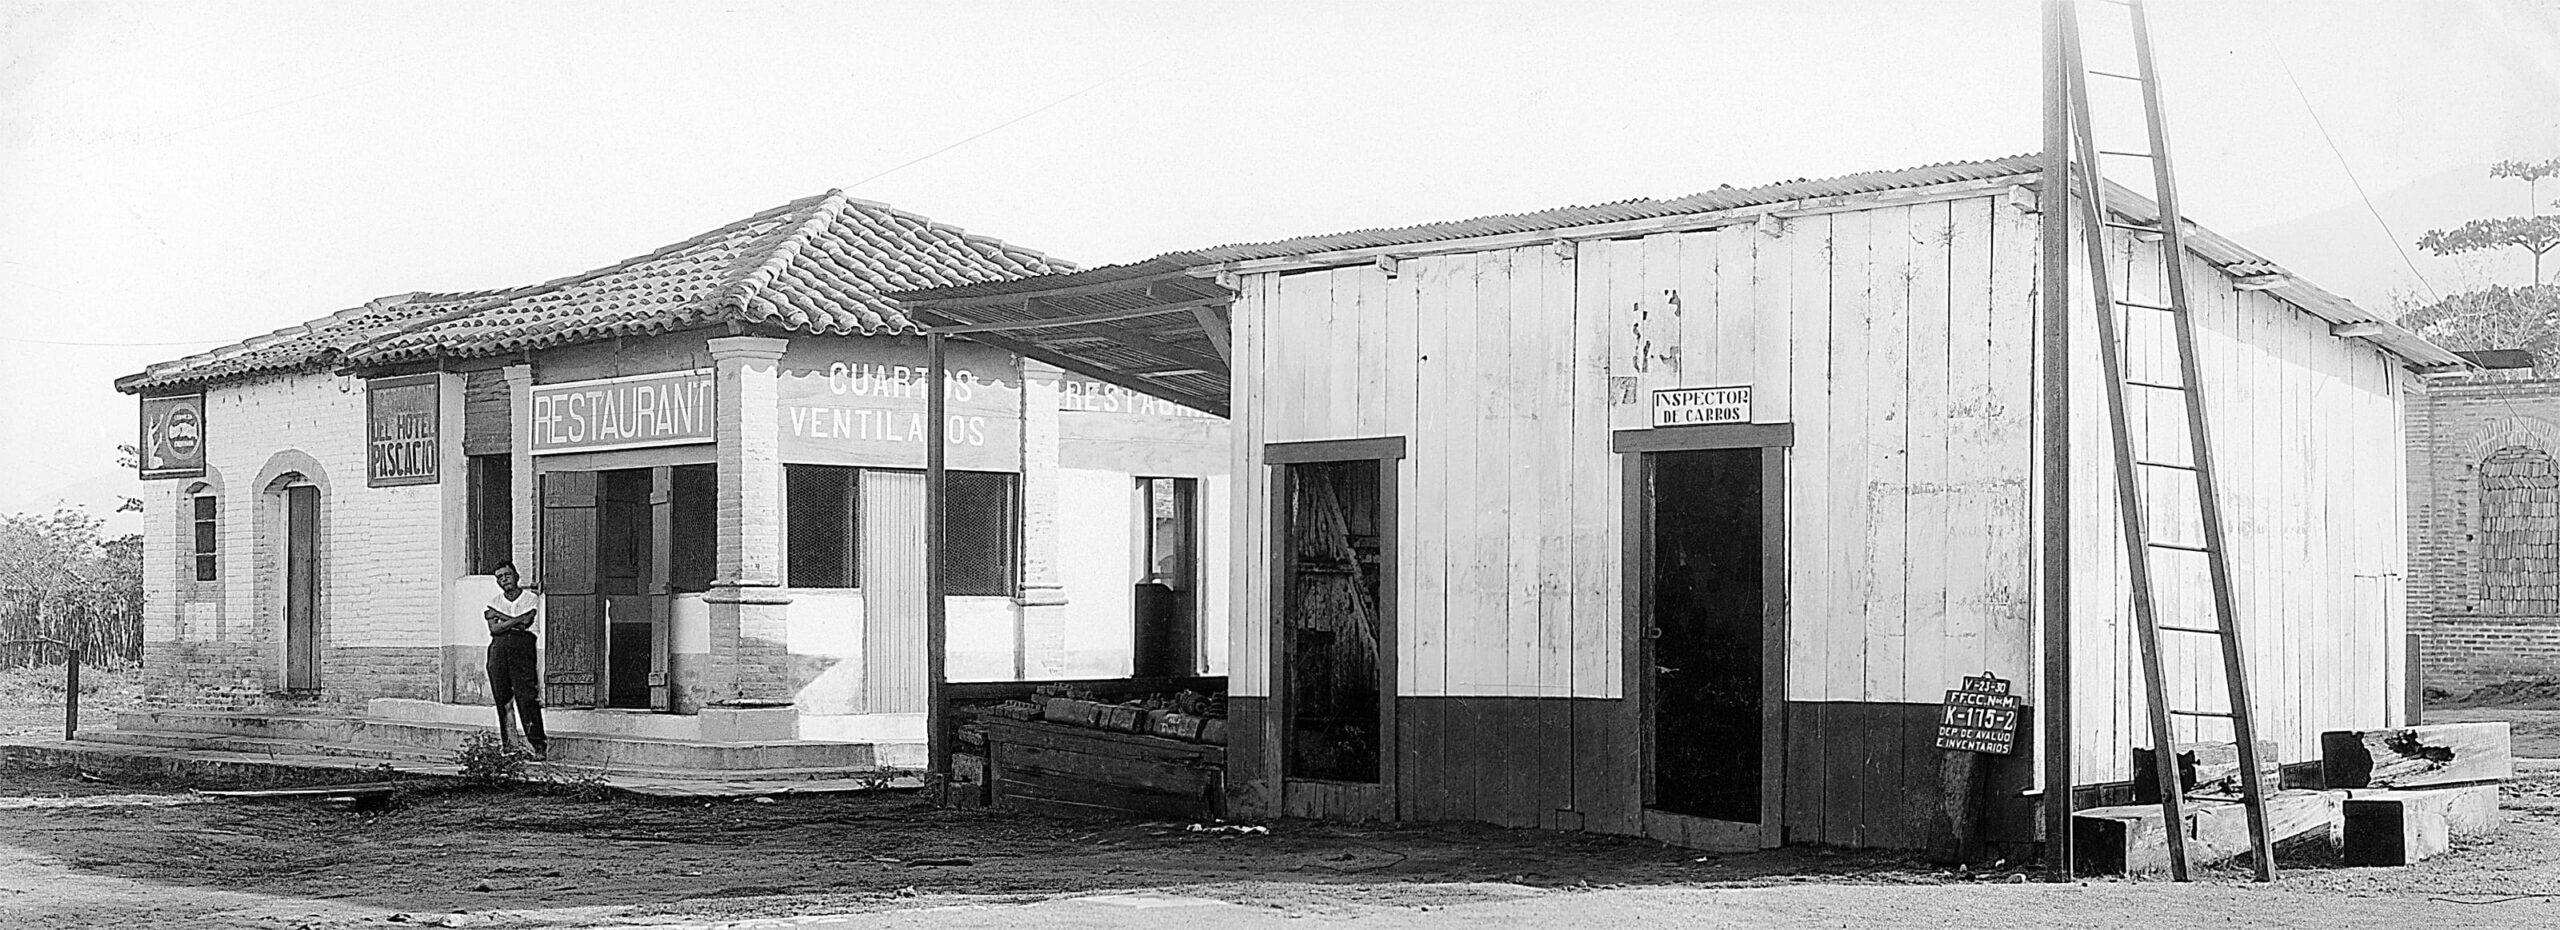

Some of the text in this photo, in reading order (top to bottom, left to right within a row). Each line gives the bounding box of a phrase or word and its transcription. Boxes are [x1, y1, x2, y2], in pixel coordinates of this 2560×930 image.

[1656, 390, 1748, 407] INSPECTOR
[535, 379, 711, 445] RESTAURANT
[1663, 407, 1740, 423] DE CARROS
[373, 413, 435, 441] DEL HOTEL
[790, 406, 985, 446] VENTILAOS
[372, 440, 435, 477] PASCACIO
[1945, 706, 2015, 731] K-175-2
[1936, 738, 2009, 754] E INVENTARIOS
[1961, 729, 1973, 738] DE
[1976, 730, 2011, 742] AVALUO
